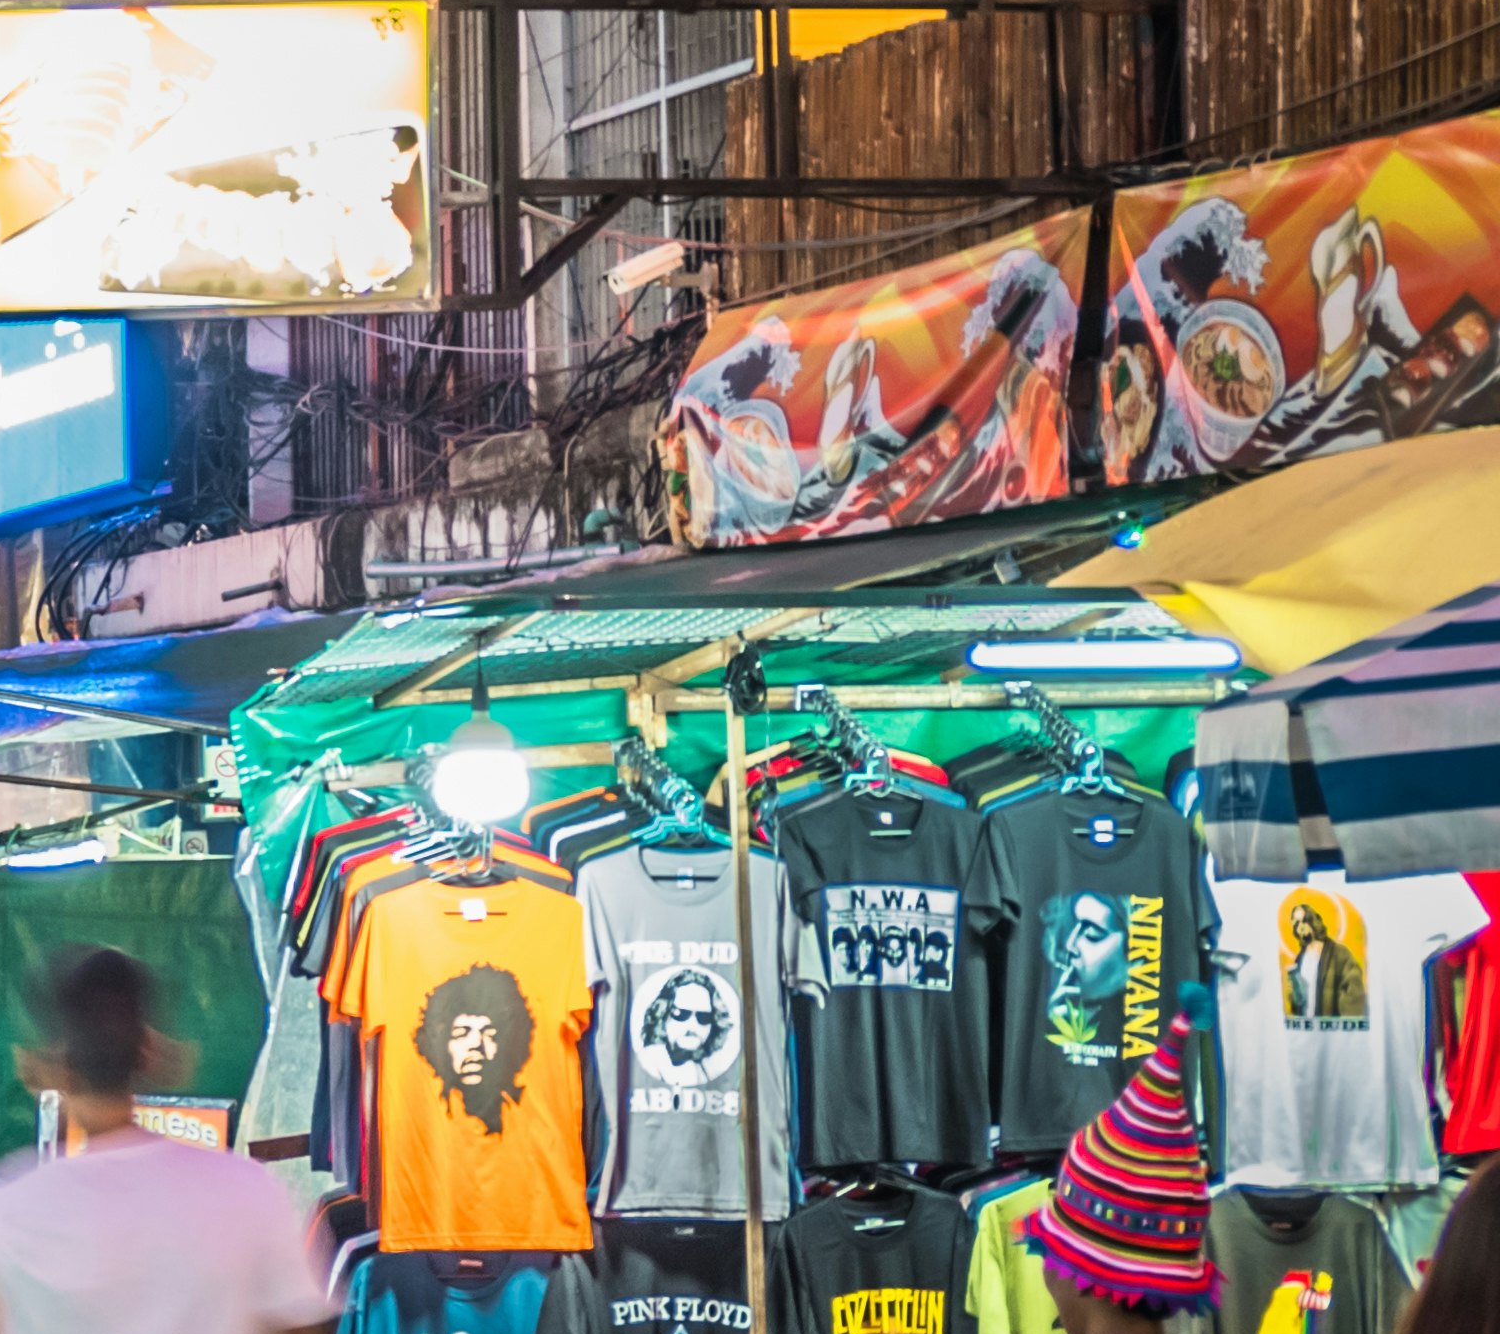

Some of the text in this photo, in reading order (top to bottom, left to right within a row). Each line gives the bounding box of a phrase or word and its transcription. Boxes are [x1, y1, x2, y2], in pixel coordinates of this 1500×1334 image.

[1121, 893, 1164, 1061] NIRVANA
[612, 1296, 752, 1330] PINK FLOYD
